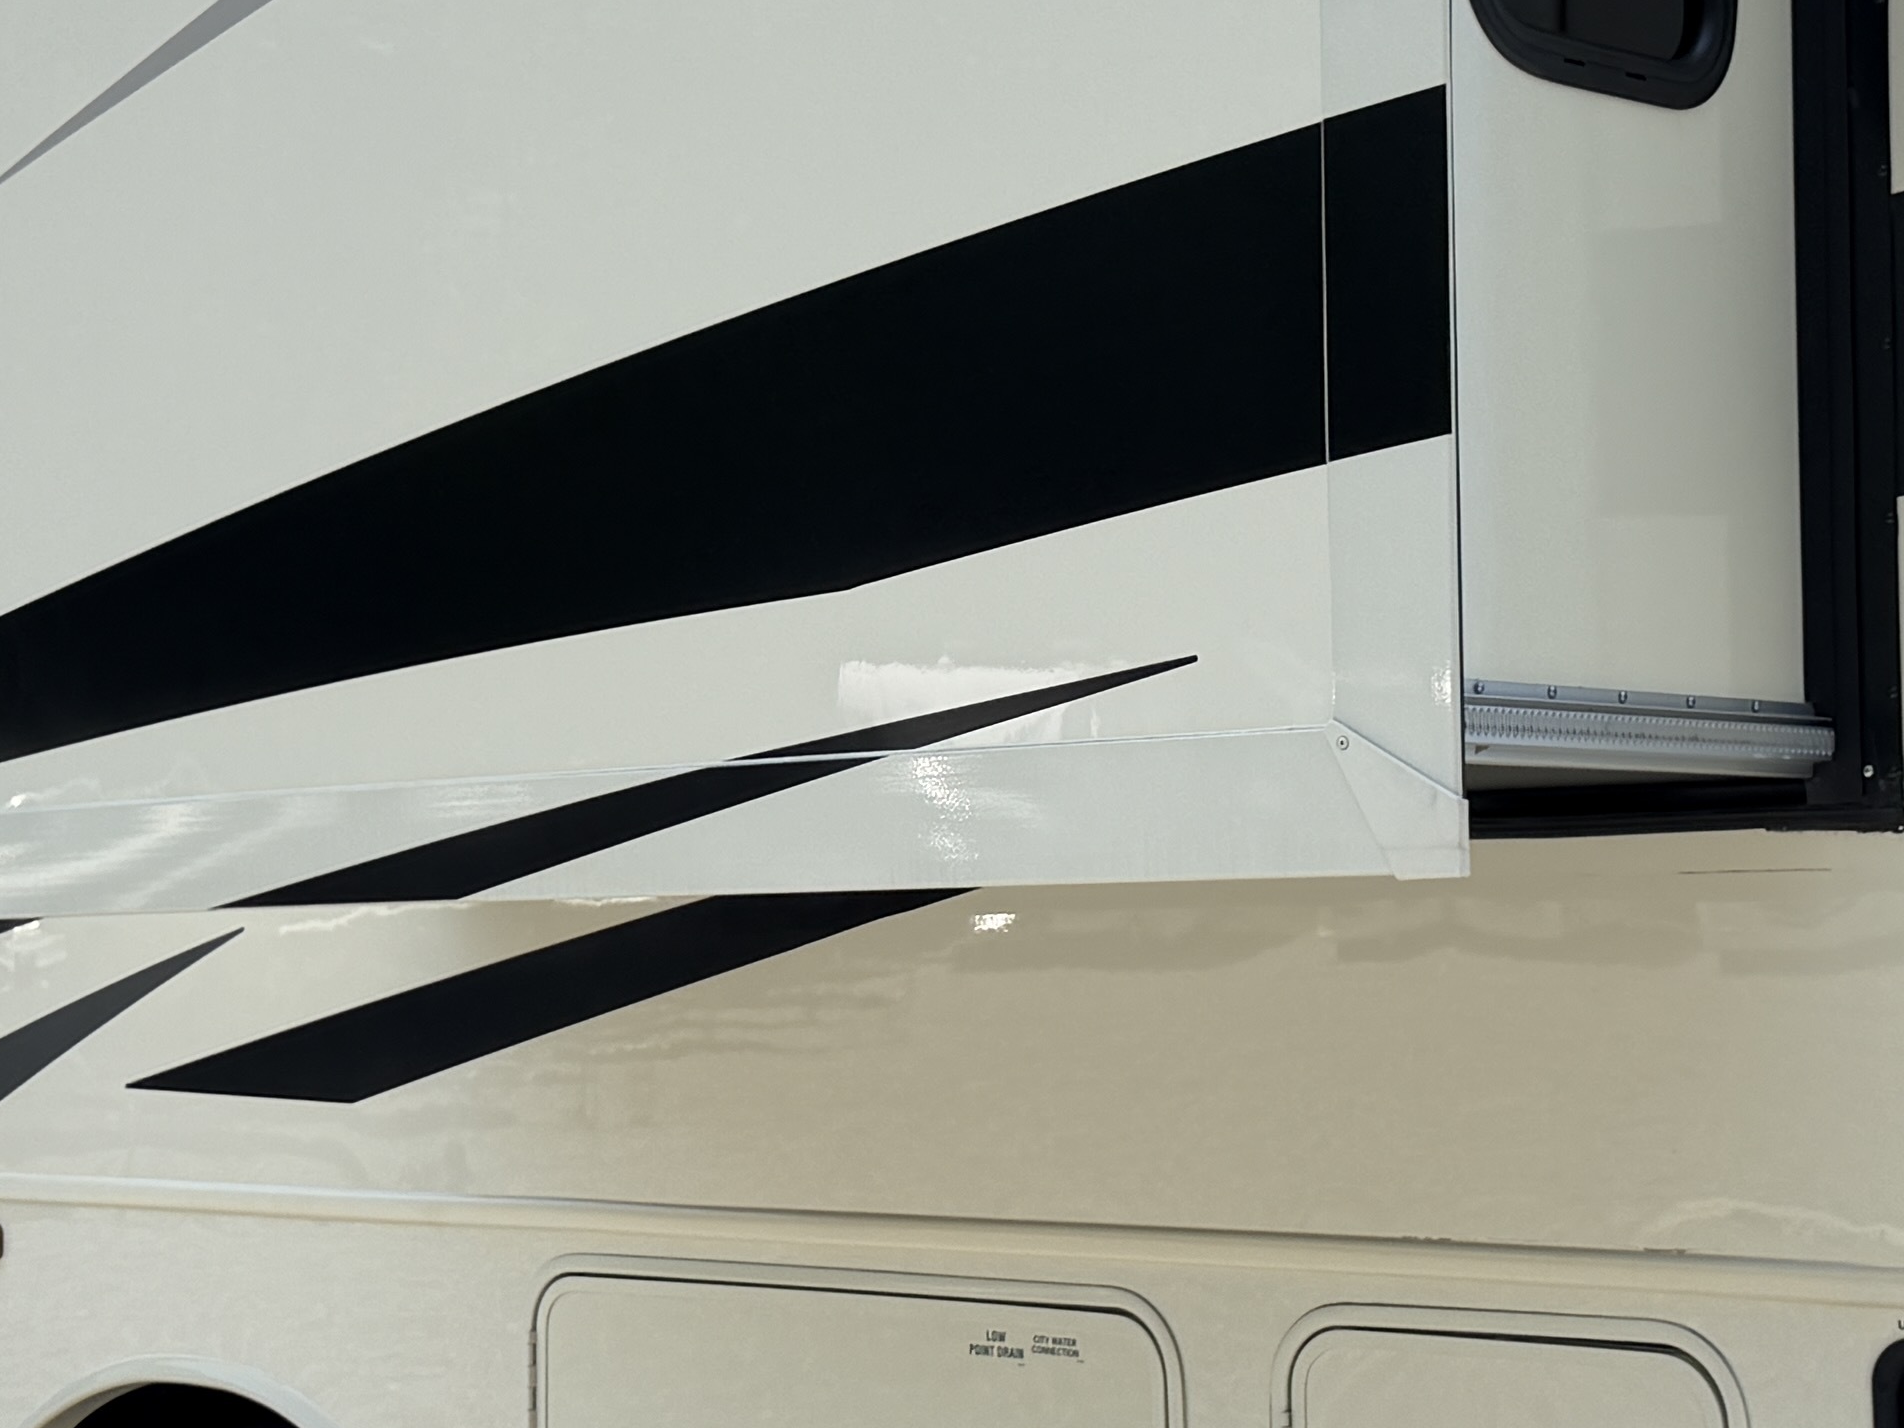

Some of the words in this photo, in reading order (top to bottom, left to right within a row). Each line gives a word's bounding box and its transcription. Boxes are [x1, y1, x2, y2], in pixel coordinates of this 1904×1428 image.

[986, 1329, 1006, 1342] LOW
[1032, 1334, 1050, 1344] CITY
[1051, 1336, 1076, 1347] WATER
[969, 1343, 995, 1357] POINT
[997, 1345, 1024, 1359] DRAIN
[1031, 1344, 1080, 1358] CONNECTION
